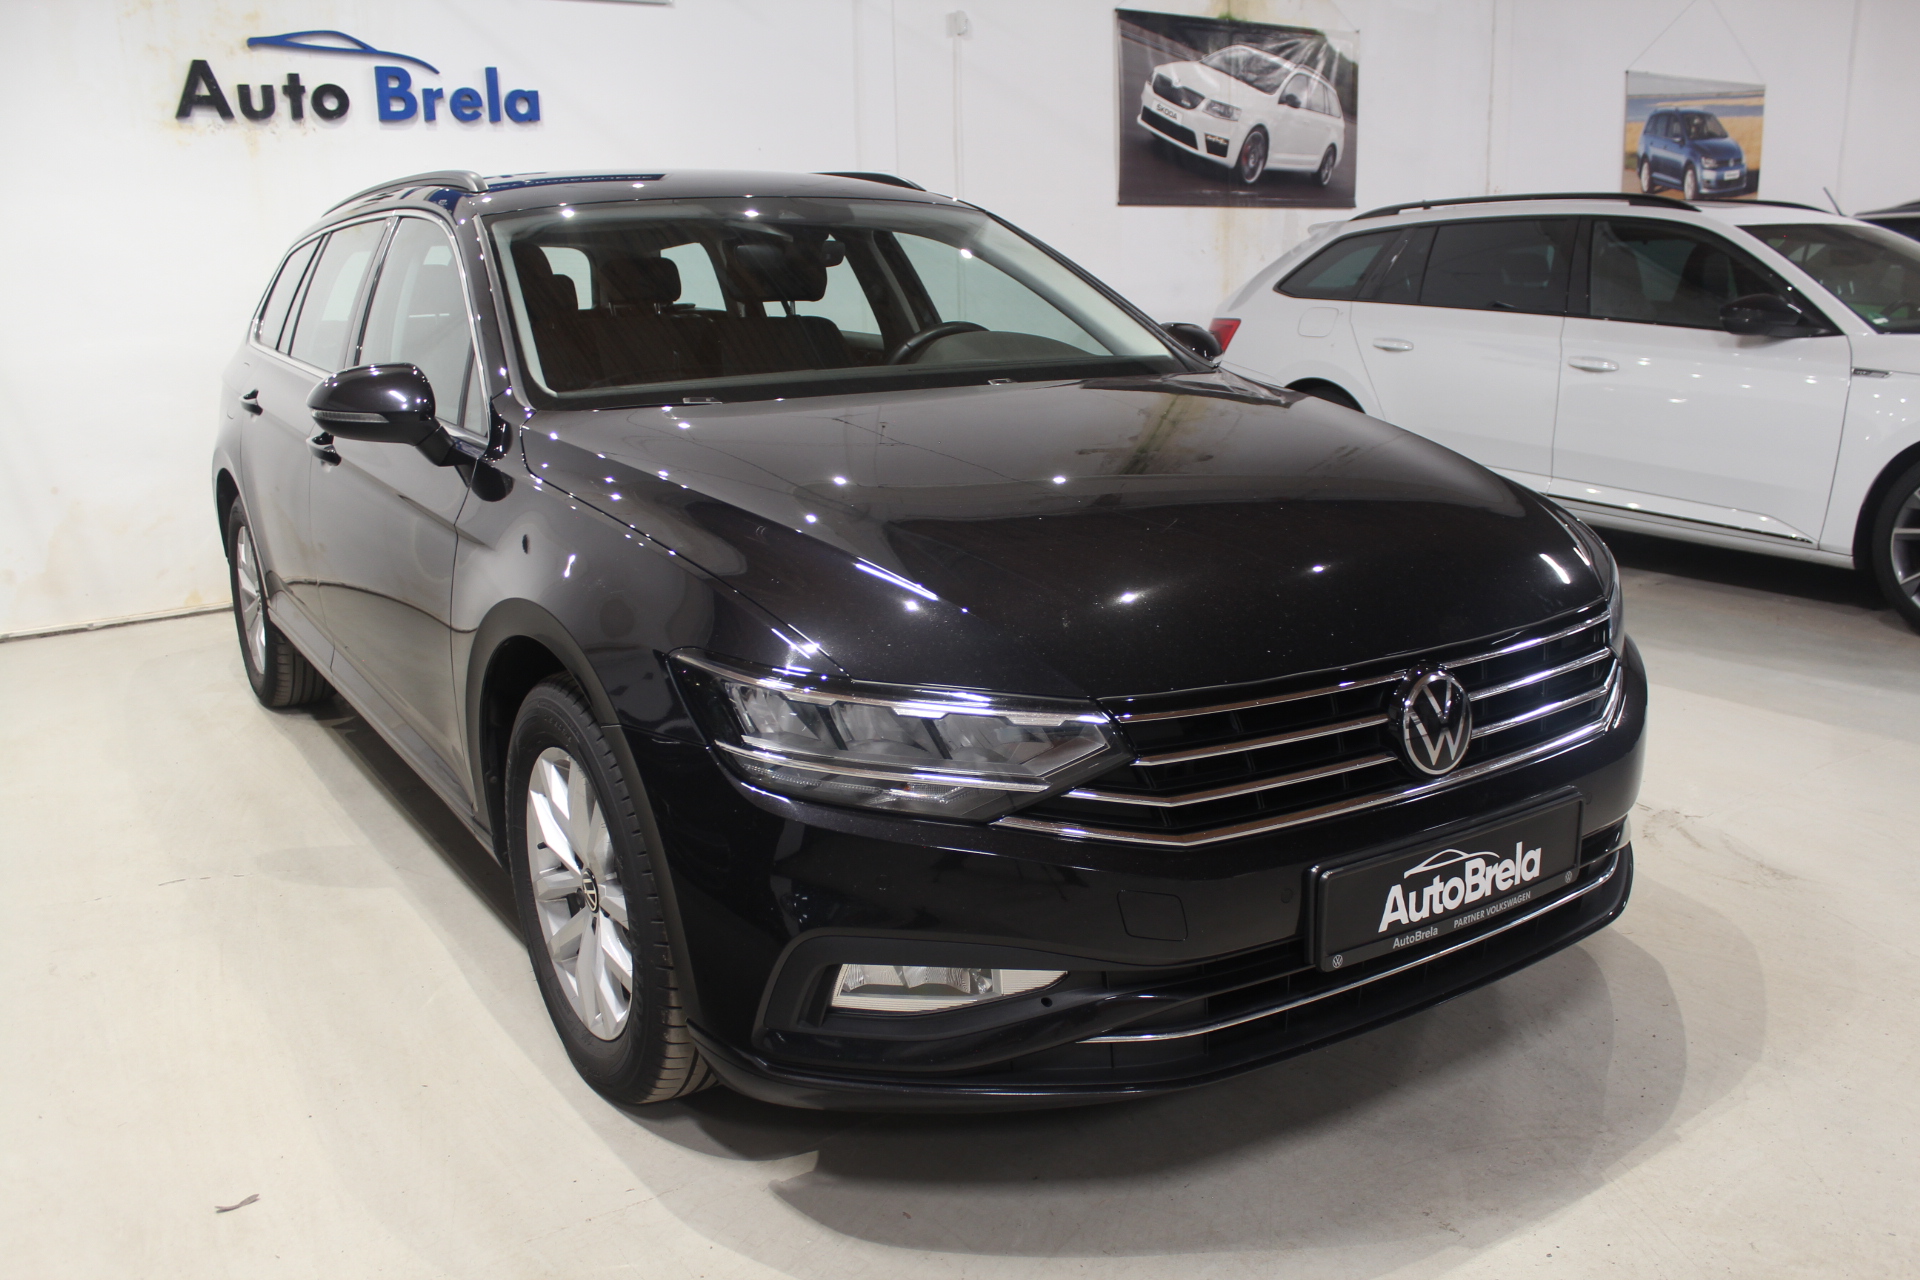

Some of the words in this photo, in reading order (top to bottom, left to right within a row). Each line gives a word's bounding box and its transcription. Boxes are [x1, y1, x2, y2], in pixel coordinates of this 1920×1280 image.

[176, 59, 350, 121] Auto
[374, 65, 540, 123] Brela
[1378, 841, 1542, 933] AutoBrela
[1453, 909, 1485, 928] PARTNER
[1485, 890, 1531, 916] VOLKSWAGEN
[1392, 926, 1439, 949] AutoBrela
